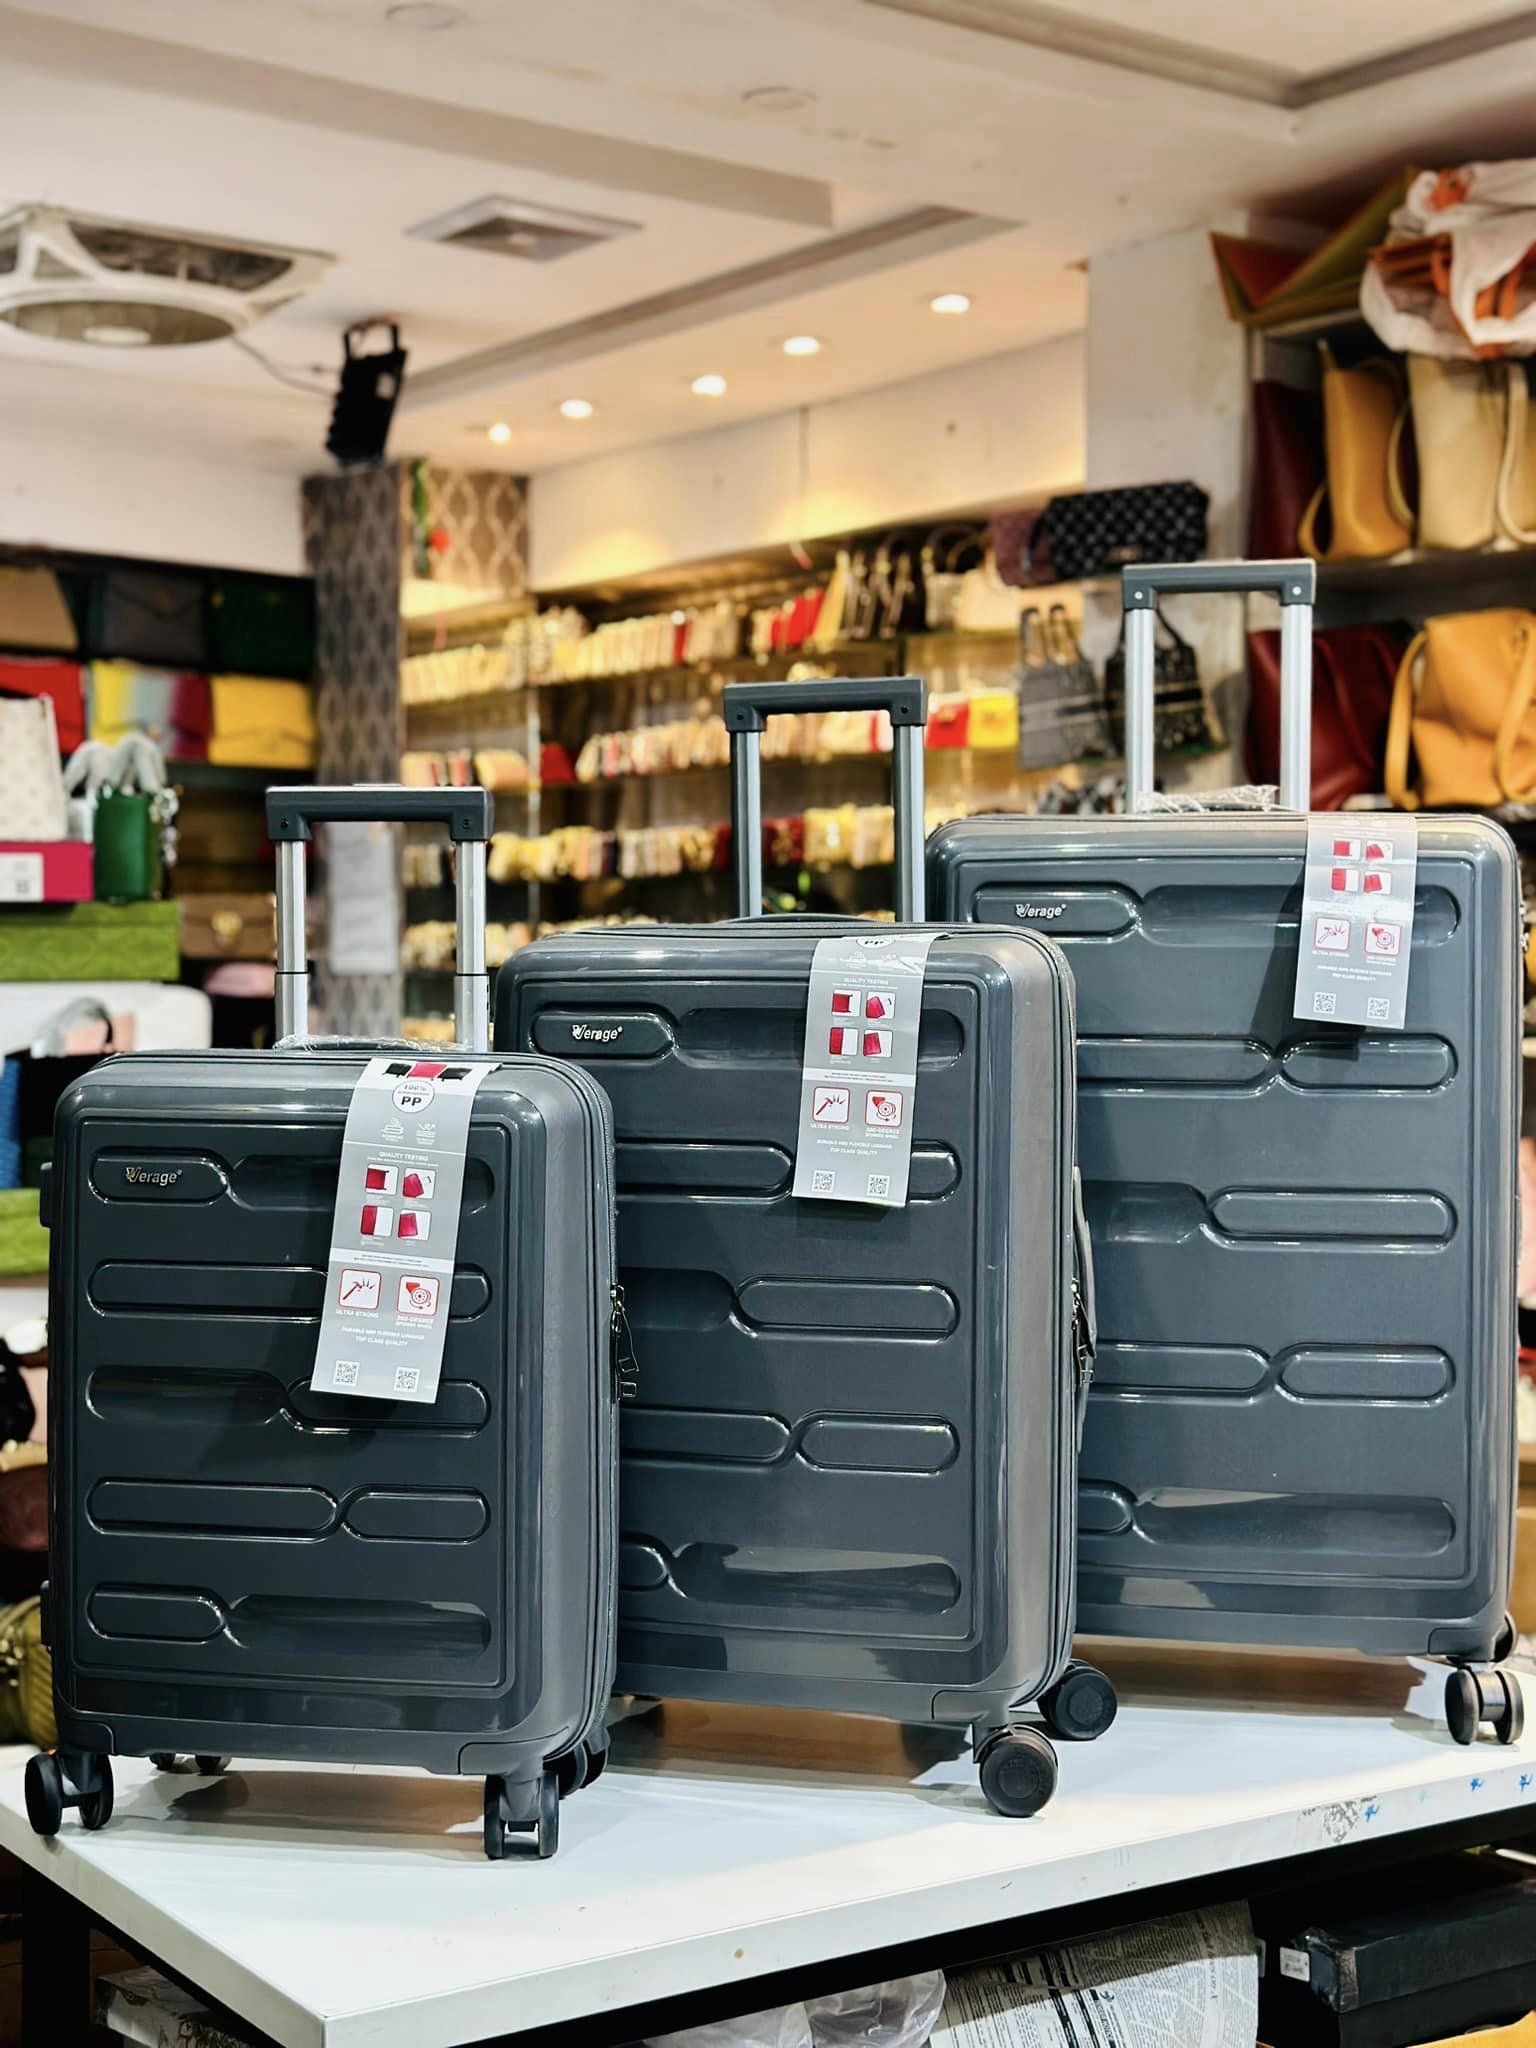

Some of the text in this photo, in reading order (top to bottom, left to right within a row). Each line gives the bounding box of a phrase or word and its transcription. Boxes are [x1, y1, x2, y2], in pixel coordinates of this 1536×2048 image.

[1016, 904, 1062, 919] Verage
[572, 1024, 618, 1042] Verage
[401, 1096, 422, 1106] PP
[379, 1151, 403, 1159] QUALITY
[404, 1153, 429, 1162] TESTING
[126, 1167, 178, 1187] Verage
[335, 1308, 379, 1319] ULTRA STRONG
